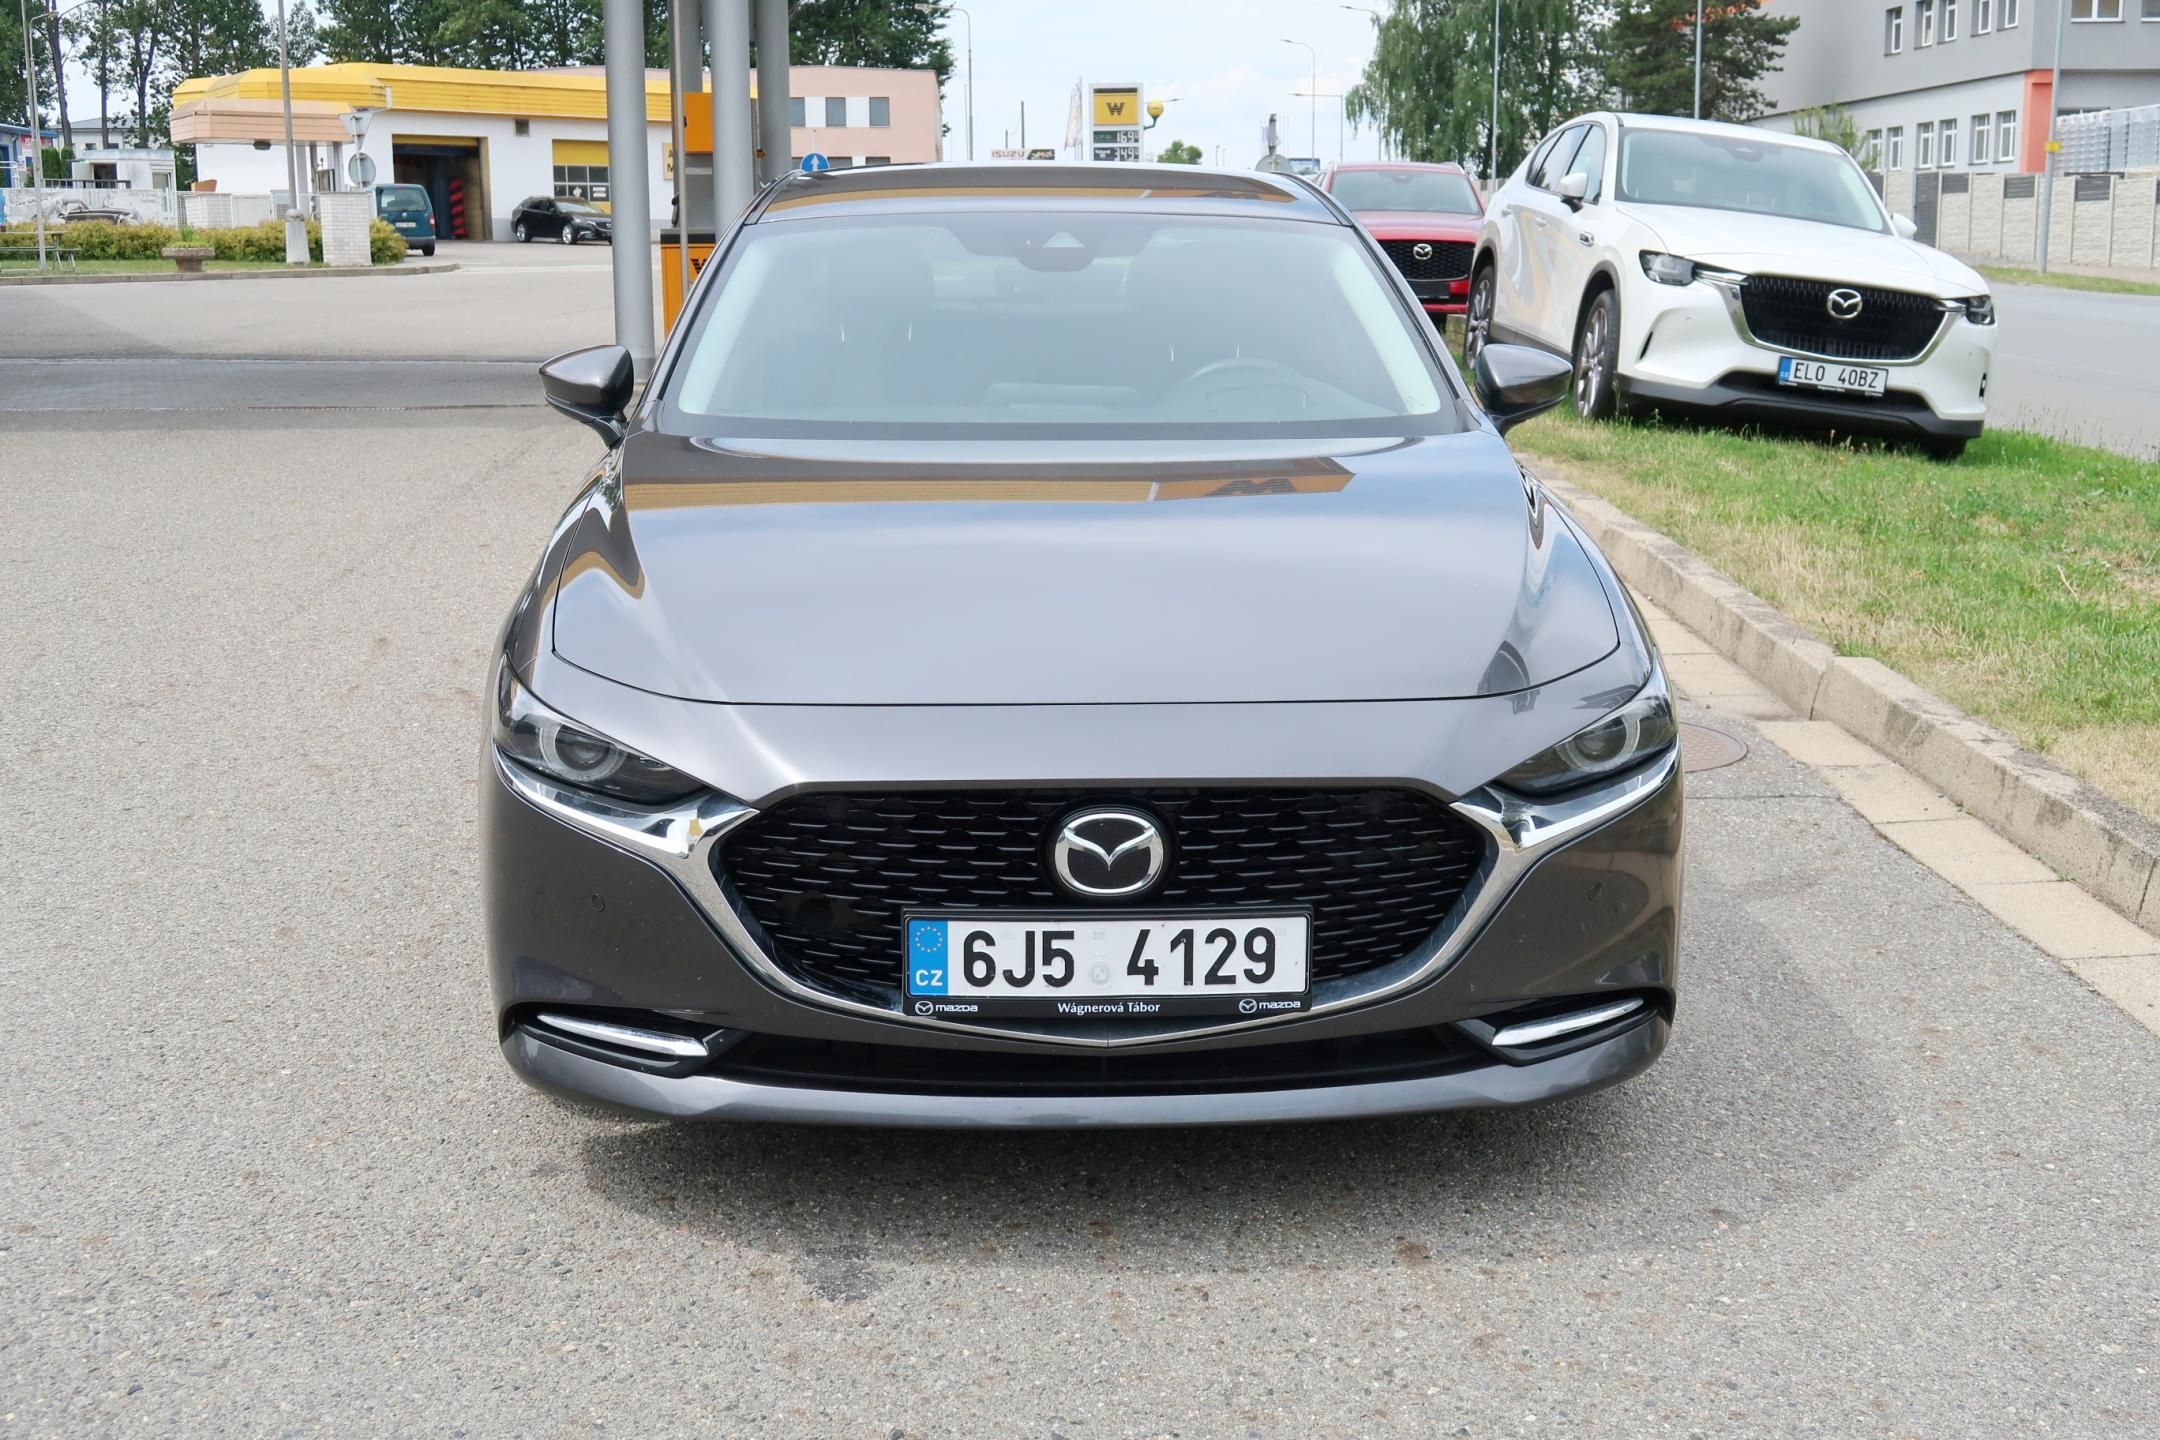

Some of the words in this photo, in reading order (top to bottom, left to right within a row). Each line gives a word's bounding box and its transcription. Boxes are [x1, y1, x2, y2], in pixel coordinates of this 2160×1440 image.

[1106, 102, 1125, 116] W
[992, 150, 1025, 158] ISUZU
[1838, 368, 1879, 388] 40BZ
[963, 930, 1075, 988] 6J5
[1126, 926, 1276, 986] 4129
[915, 969, 943, 986] CZ
[935, 1005, 978, 1013] mazda
[1057, 1002, 1124, 1016] Wágnerová
[1127, 1002, 1161, 1013] Tábor
[1259, 1001, 1301, 1010] mazda
